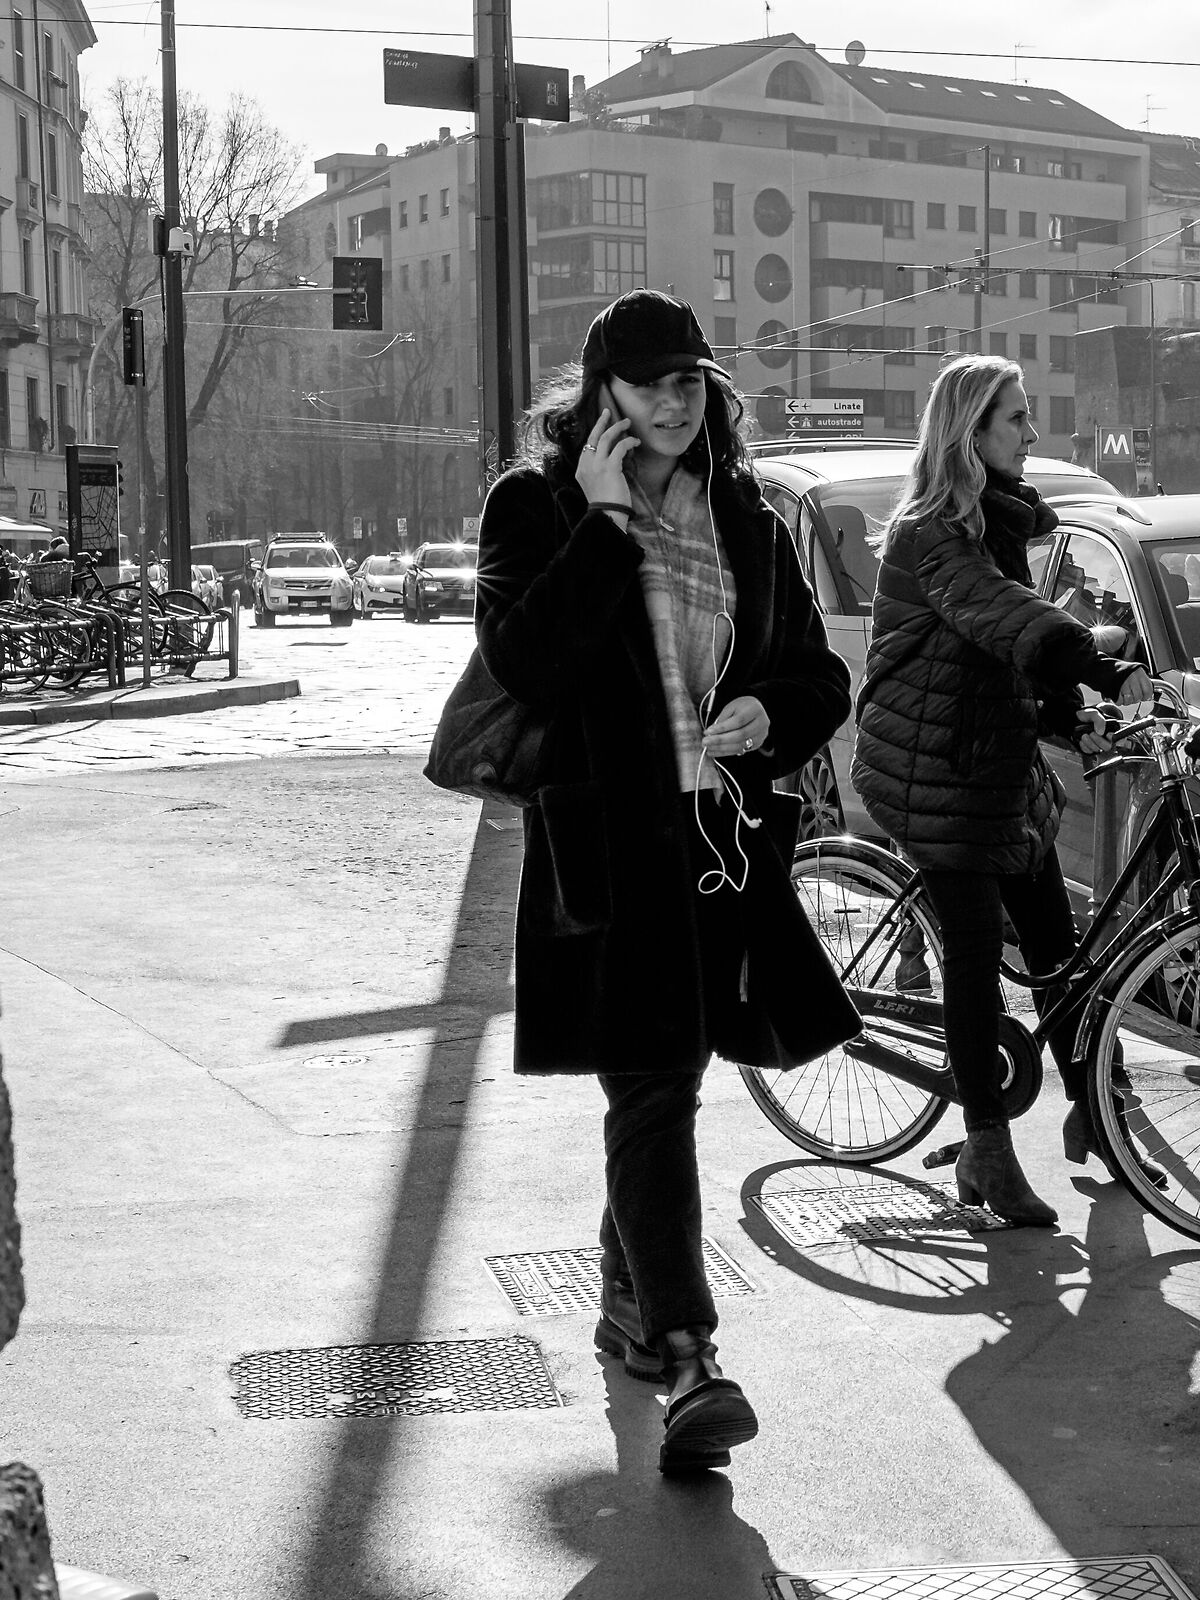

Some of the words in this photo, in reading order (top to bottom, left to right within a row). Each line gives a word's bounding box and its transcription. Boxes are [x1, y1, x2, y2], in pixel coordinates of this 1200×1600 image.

[833, 402, 861, 410] Linate
[817, 418, 862, 426] autostrade
[1103, 433, 1130, 455] M
